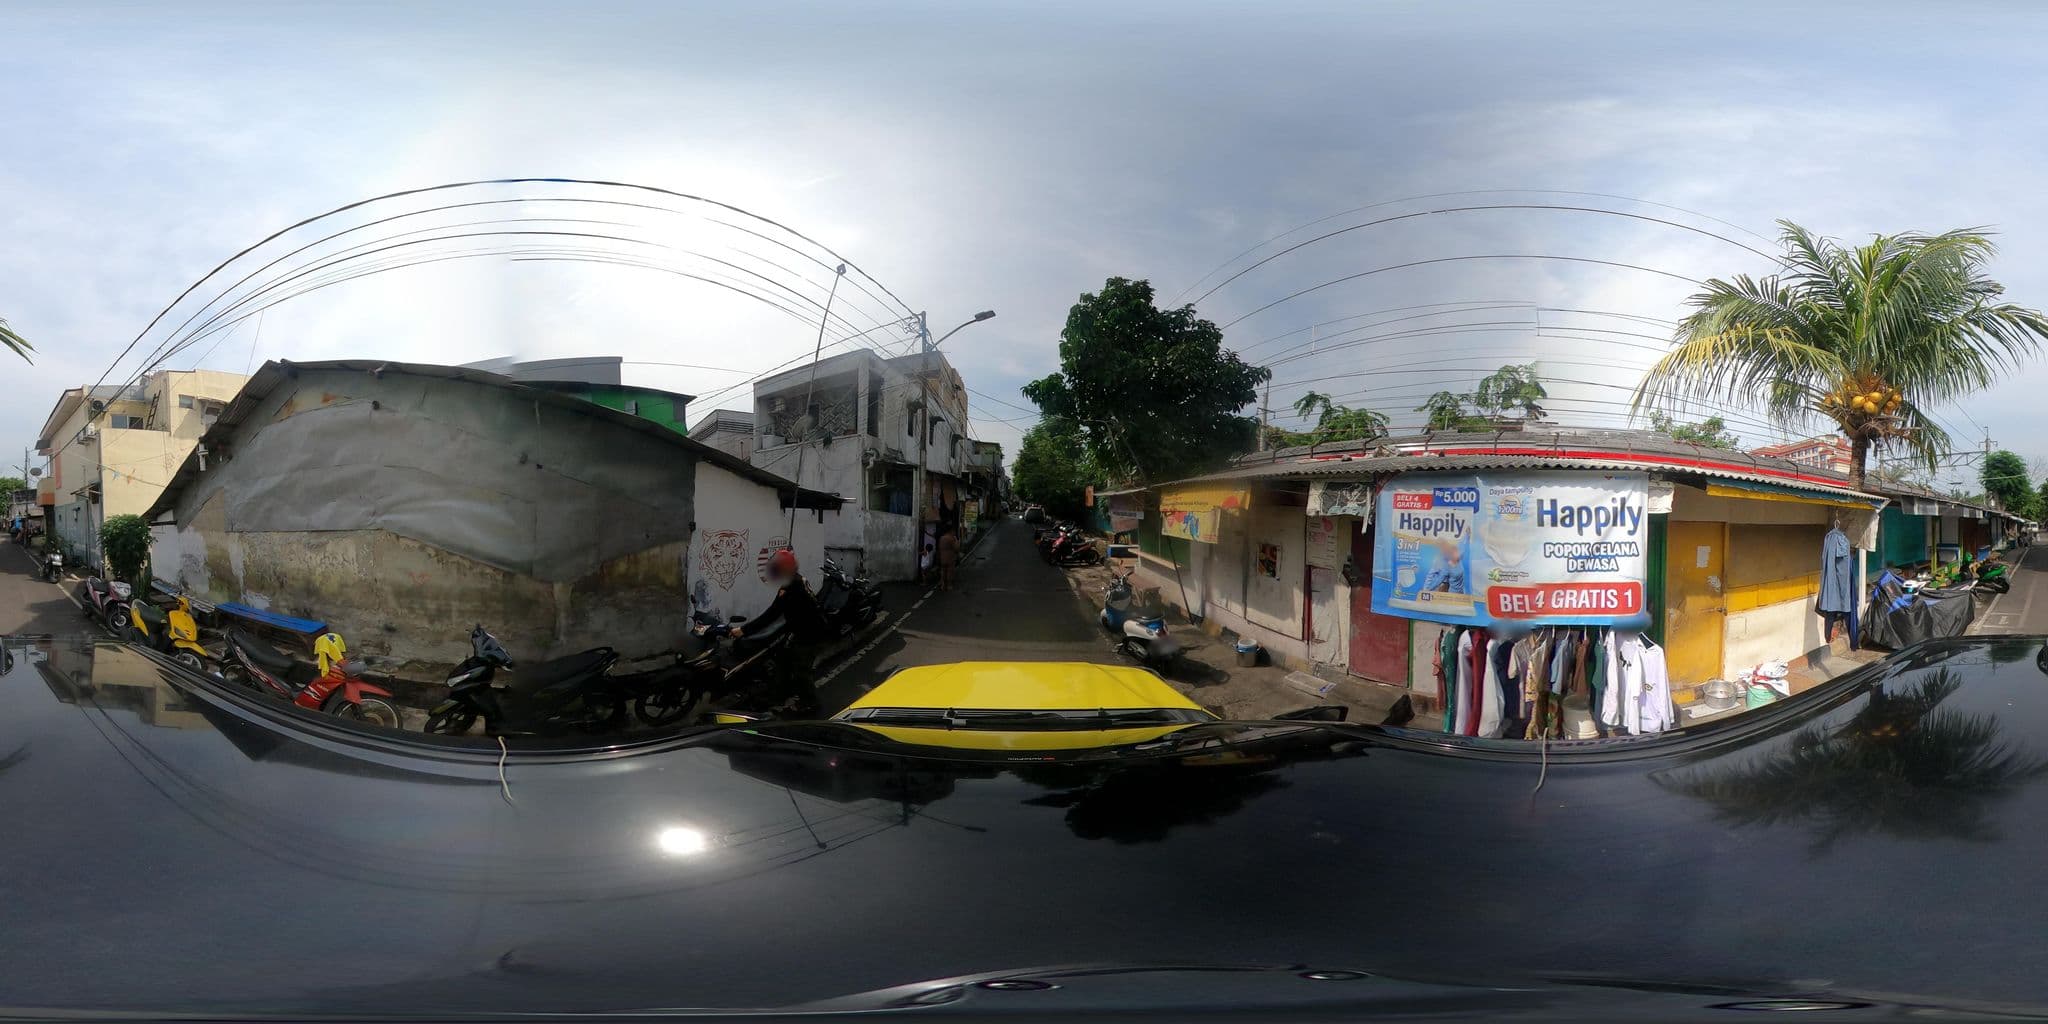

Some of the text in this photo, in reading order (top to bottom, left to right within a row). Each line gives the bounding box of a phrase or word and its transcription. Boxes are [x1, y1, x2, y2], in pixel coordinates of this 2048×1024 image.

[1489, 487, 1533, 496] Daya tampung
[1399, 513, 1466, 538] Happily
[1537, 497, 1643, 536] Happily
[1544, 542, 1639, 558] POPOK CELANA
[1567, 557, 1619, 572] DEWASA
[1535, 590, 1545, 608] 4
[1552, 589, 1618, 609] GRATIS
[1624, 589, 1633, 608] 1
